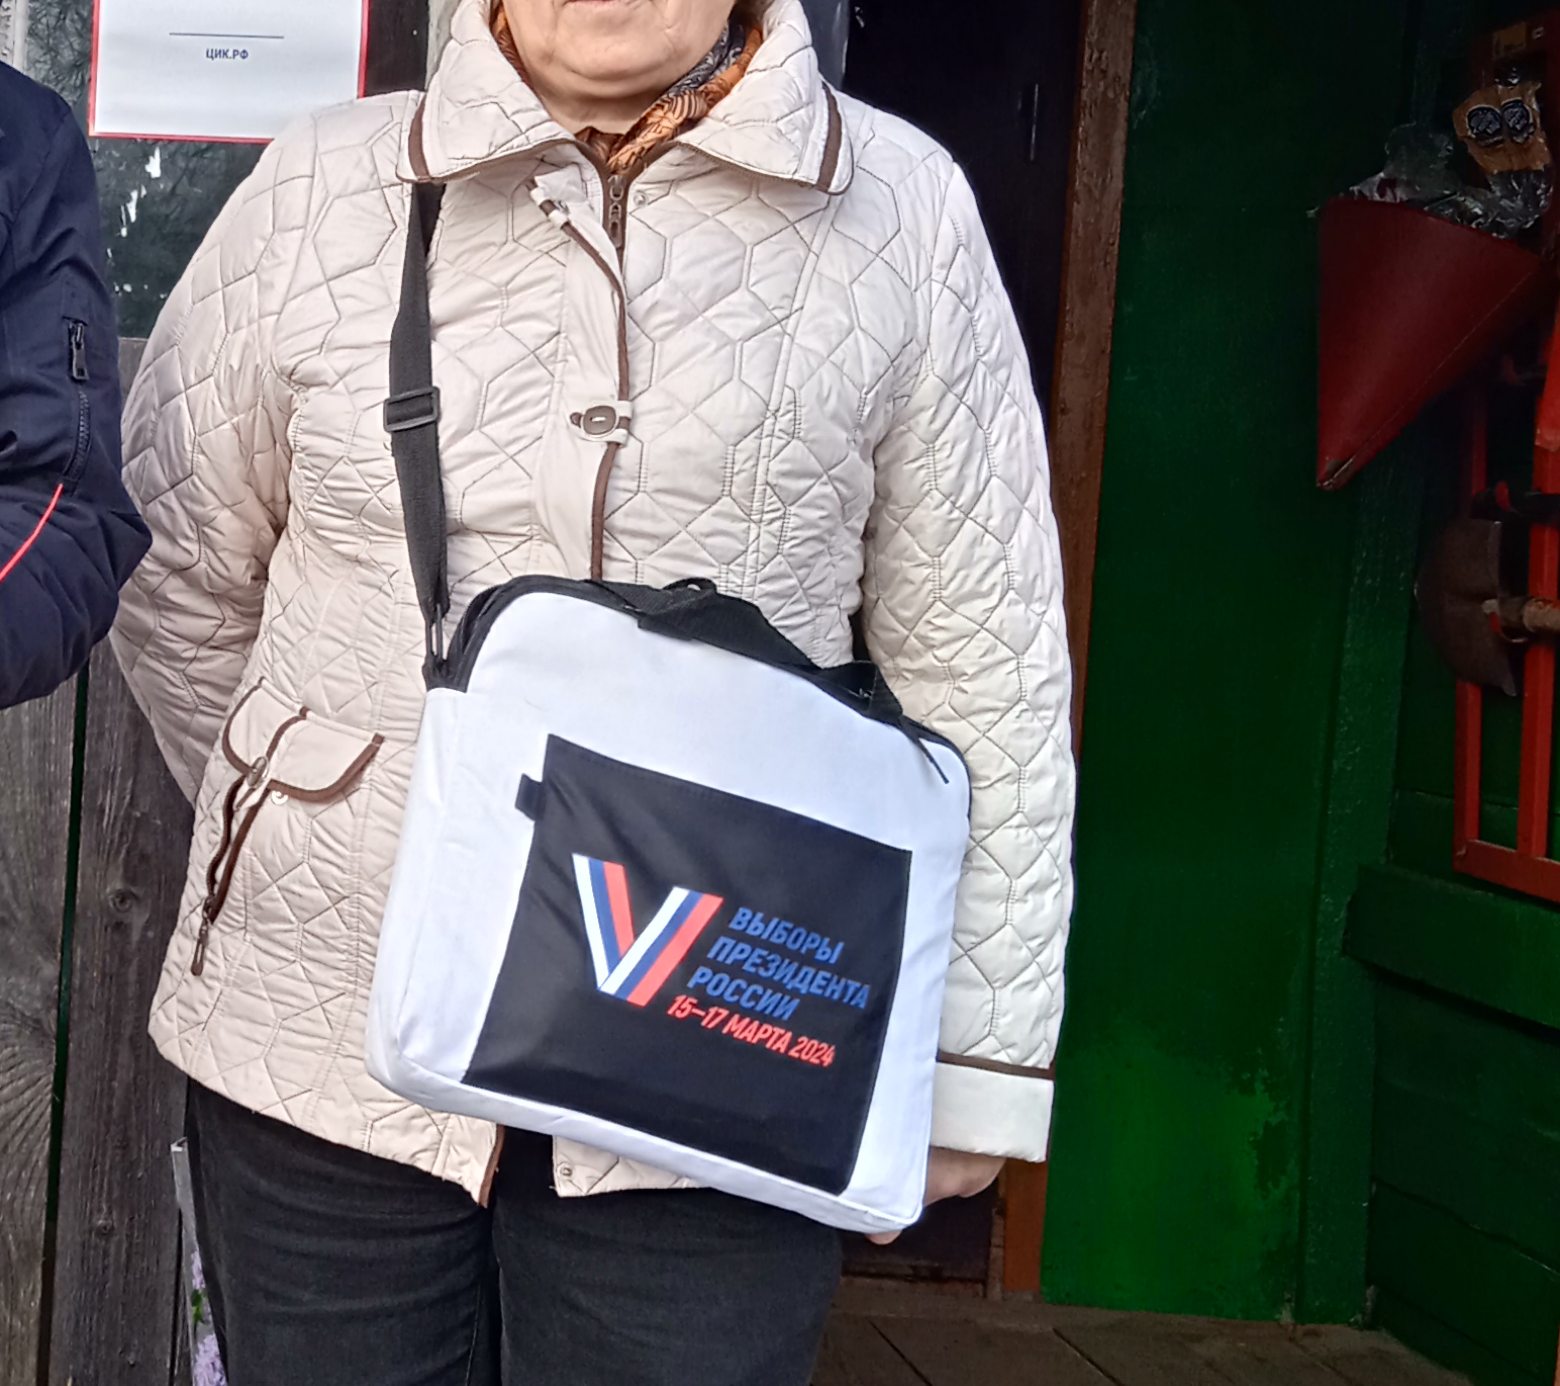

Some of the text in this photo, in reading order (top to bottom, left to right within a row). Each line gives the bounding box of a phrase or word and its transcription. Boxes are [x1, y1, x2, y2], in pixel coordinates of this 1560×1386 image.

[206, 48, 249, 61] ЦИК.РФ
[729, 907, 845, 965] ВЫБОРЫ
[687, 966, 800, 1022] РОССИИ
[706, 936, 872, 1010] ПРЕЗИДЕНТА
[721, 1013, 793, 1055] МАРТА
[788, 1036, 836, 1068] 2024
